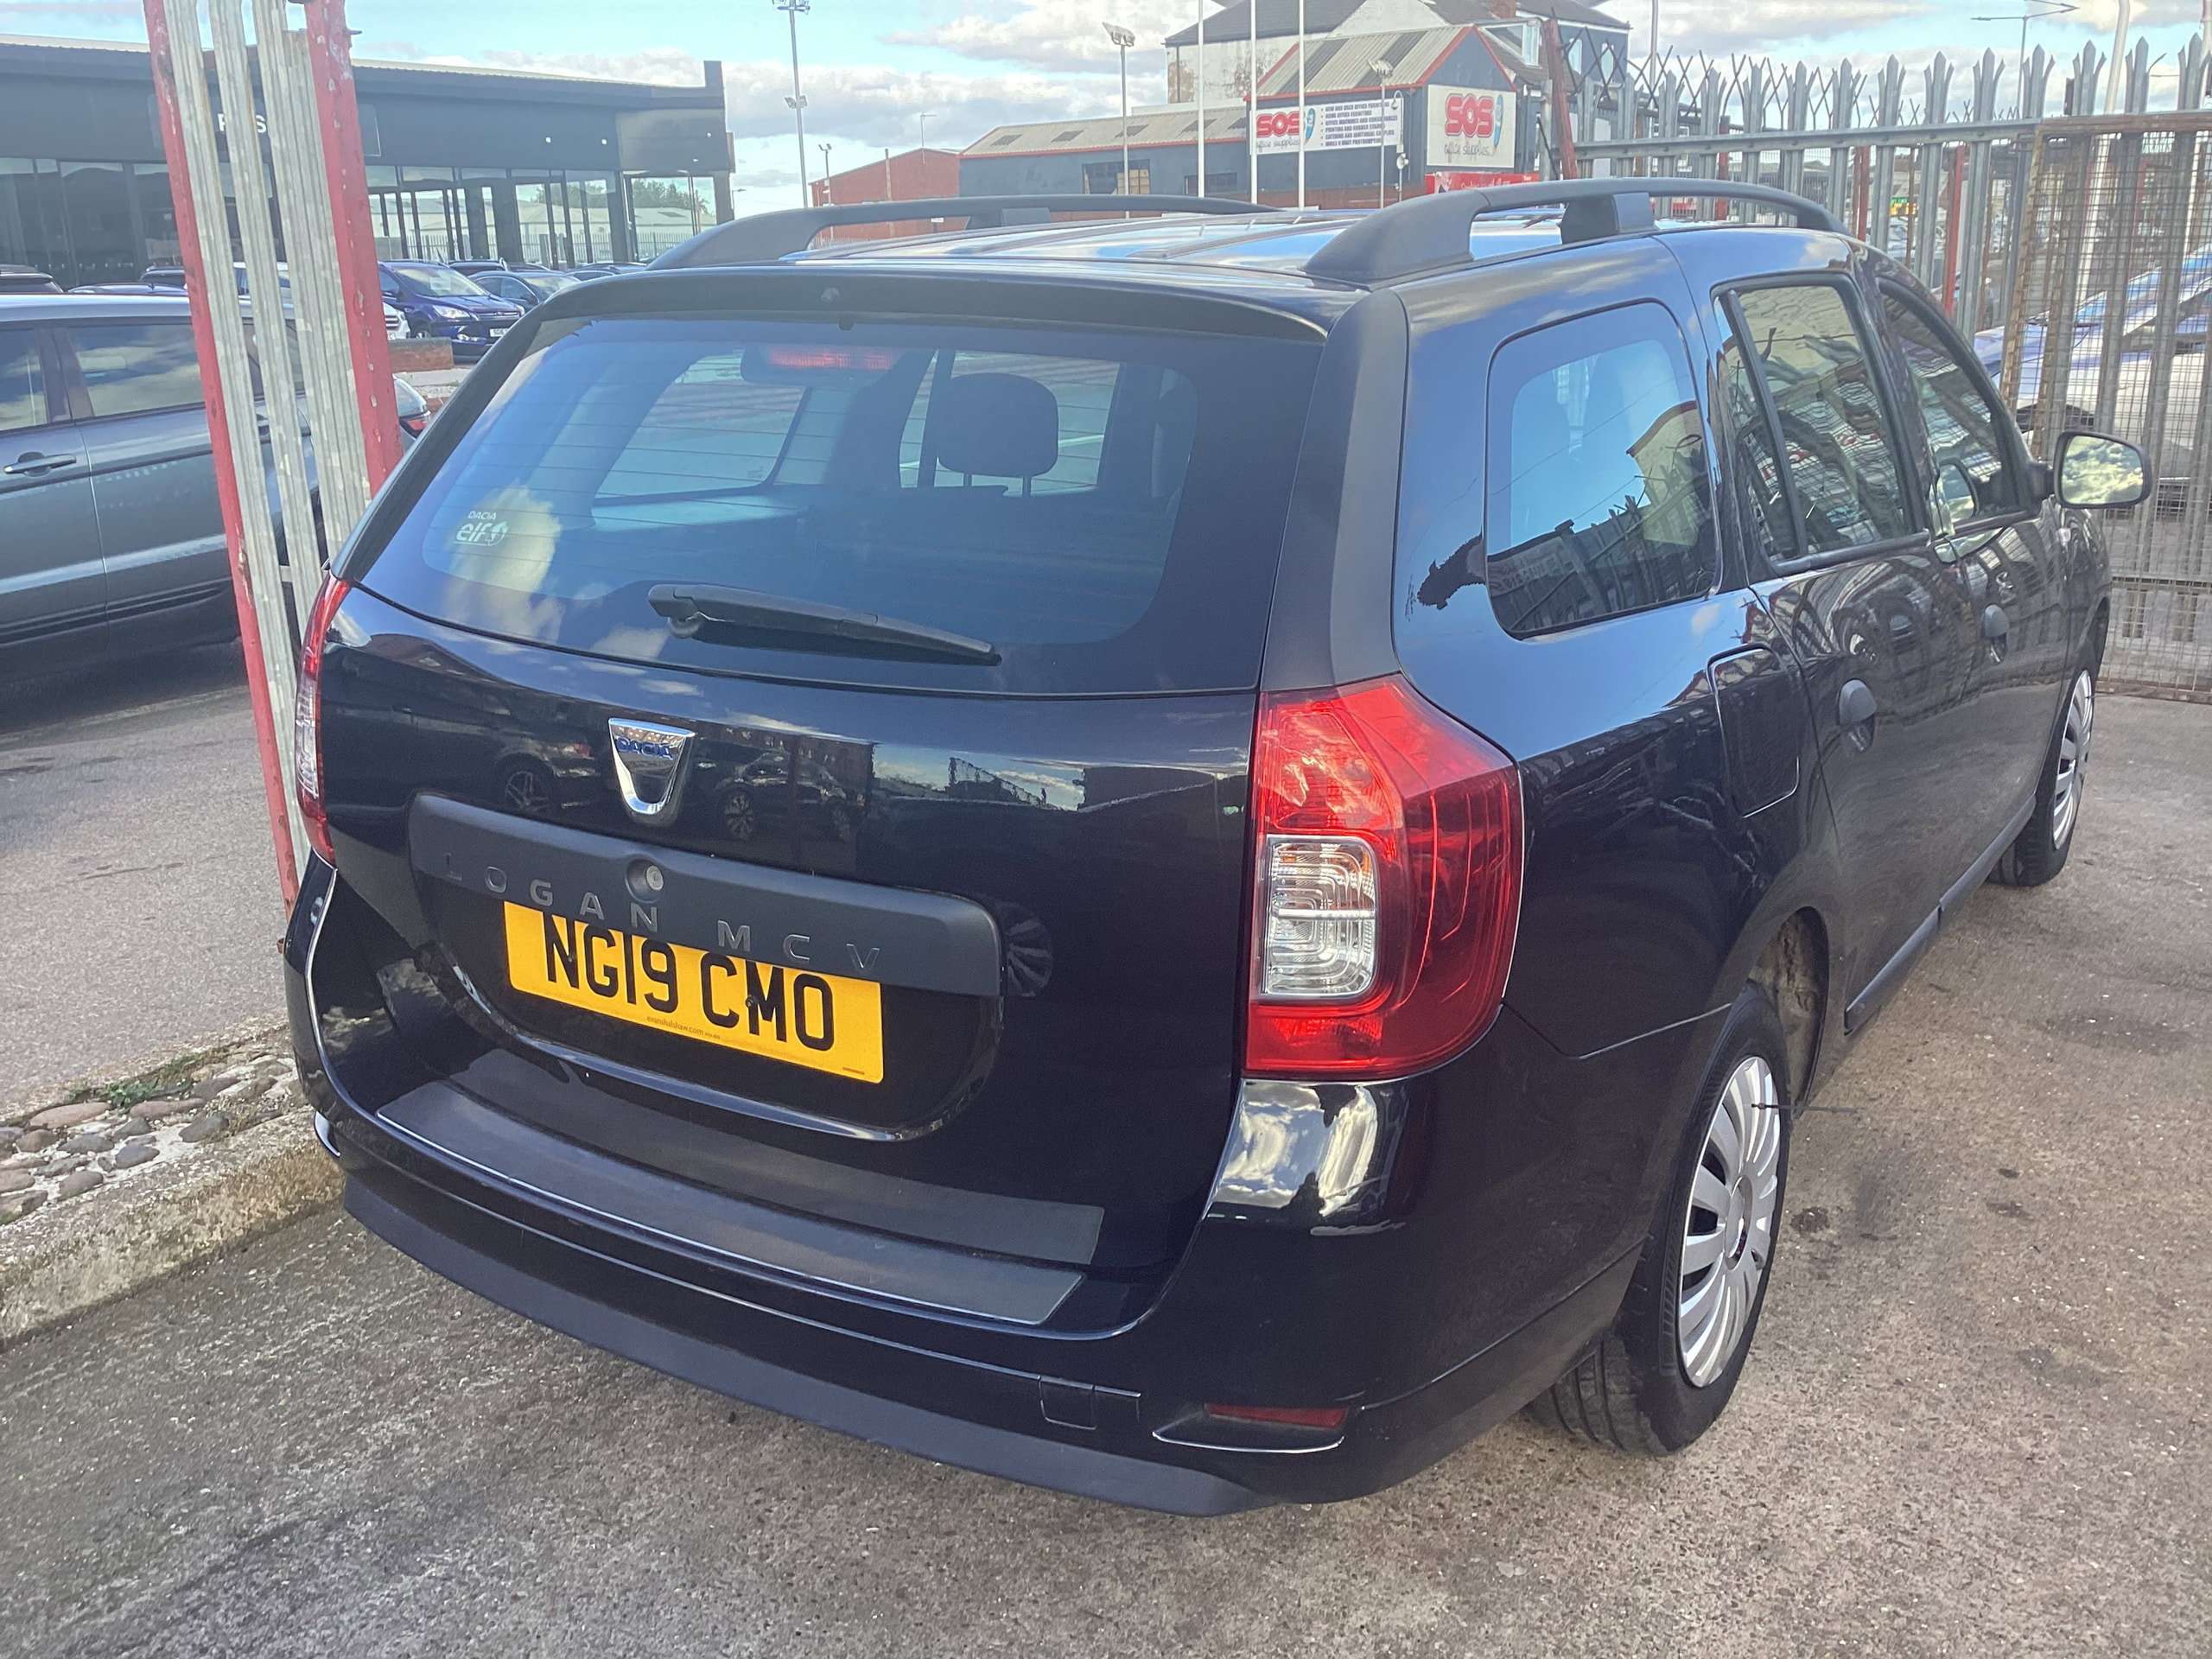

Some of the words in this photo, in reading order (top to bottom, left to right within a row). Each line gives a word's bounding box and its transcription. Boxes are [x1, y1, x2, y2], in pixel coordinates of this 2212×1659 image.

[1445, 93, 1494, 138] SOS
[456, 522, 492, 542] elf
[467, 511, 497, 520] DACIA
[616, 736, 674, 760] DACIA
[444, 853, 658, 933] LOGAN
[717, 919, 880, 970] MCV
[542, 912, 678, 1014] NG19
[700, 951, 834, 1052] CMO
